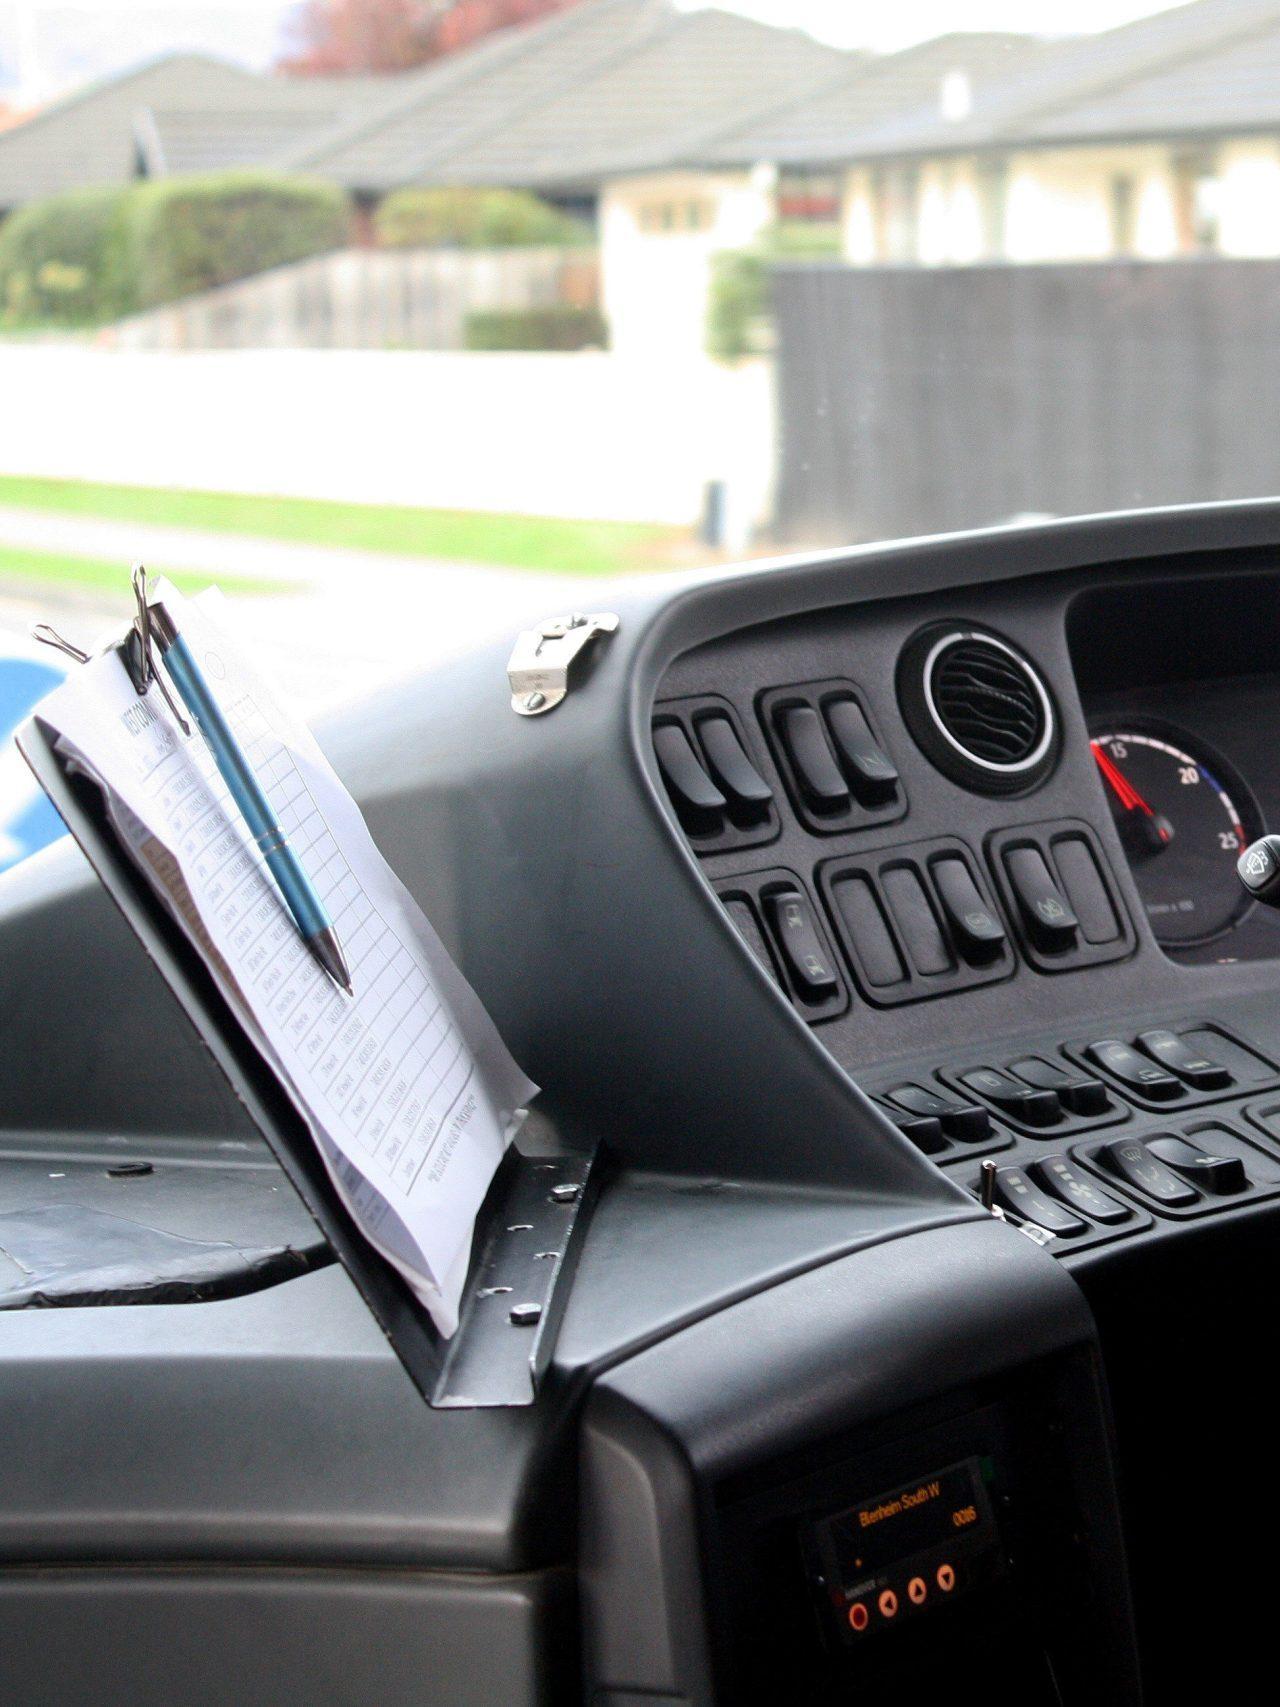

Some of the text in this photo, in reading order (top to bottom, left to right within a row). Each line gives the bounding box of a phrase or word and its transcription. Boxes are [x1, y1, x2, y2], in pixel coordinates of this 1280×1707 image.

[1110, 742, 1127, 758] 15
[1177, 766, 1200, 785] 20
[1218, 831, 1239, 850] 25
